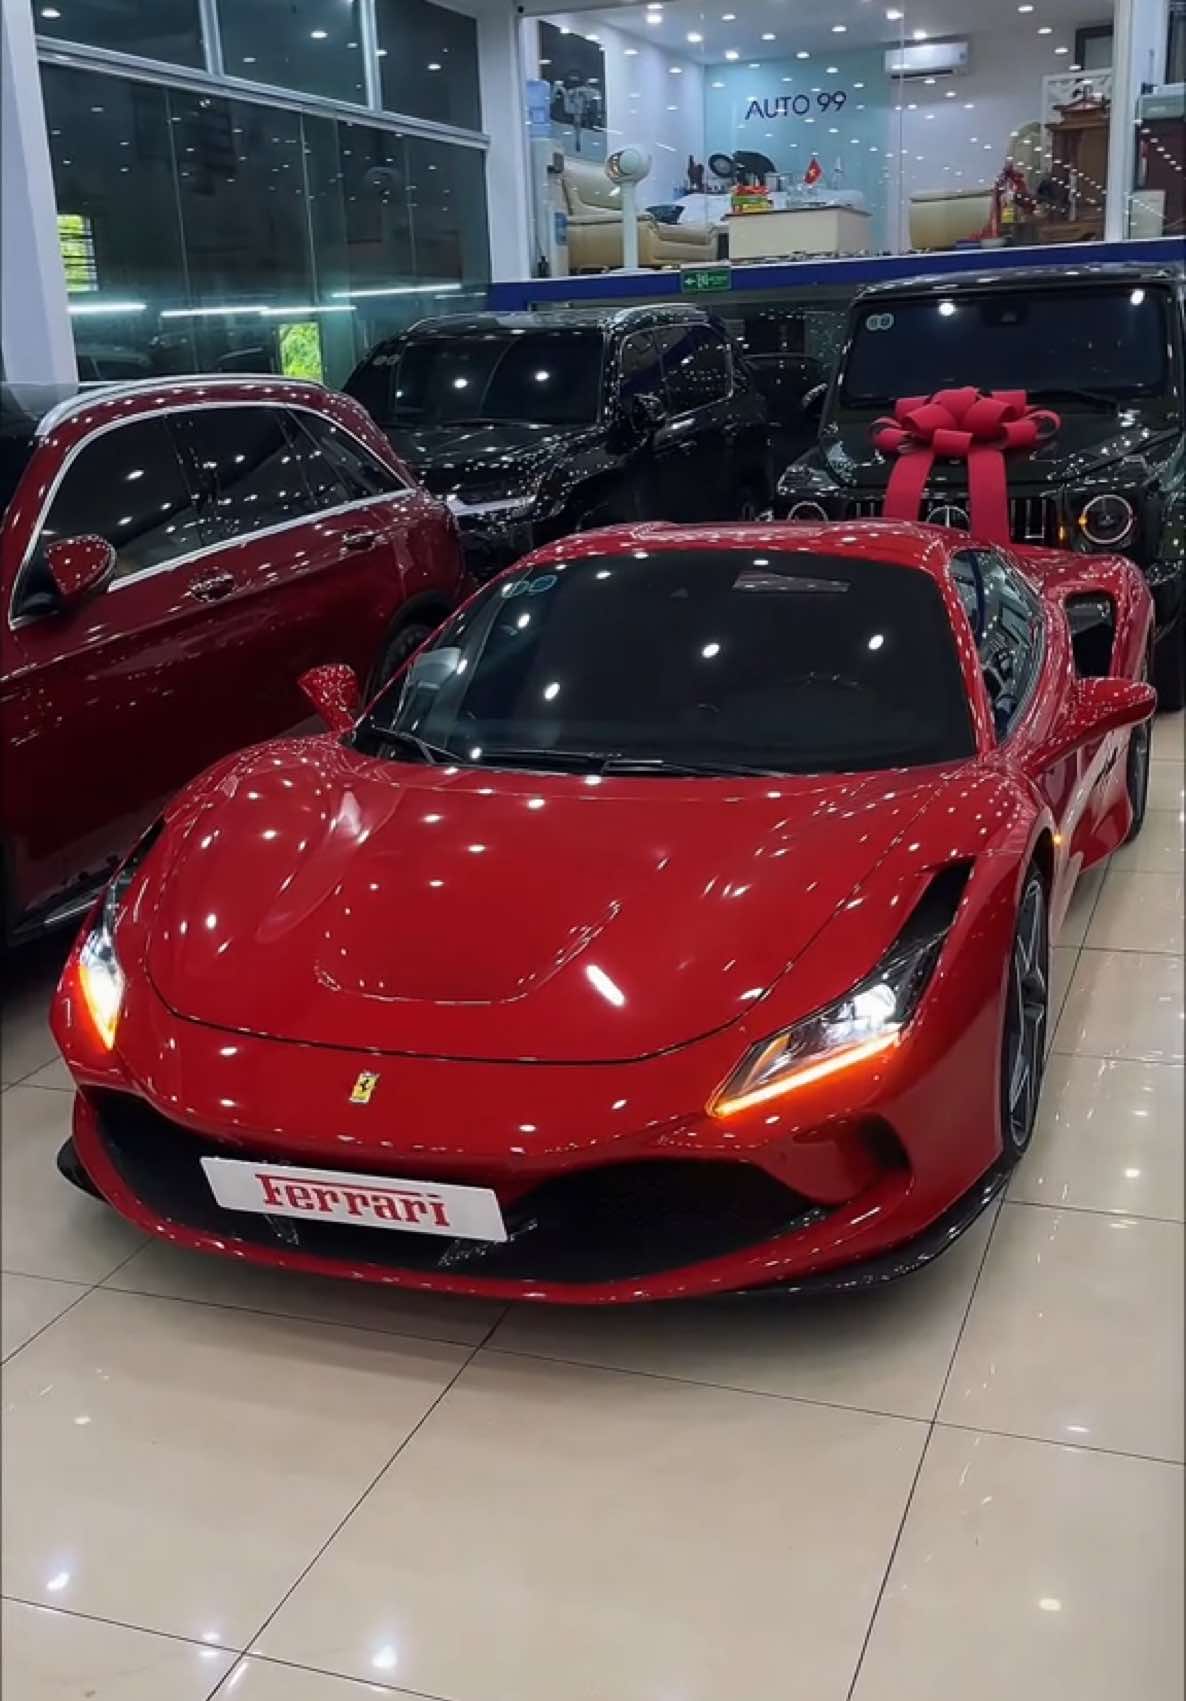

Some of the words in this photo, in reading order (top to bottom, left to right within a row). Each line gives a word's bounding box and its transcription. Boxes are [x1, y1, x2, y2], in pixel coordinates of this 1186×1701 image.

[745, 94, 810, 120] AUTO
[816, 90, 847, 112] 99
[255, 1173, 450, 1227] Ferrari
